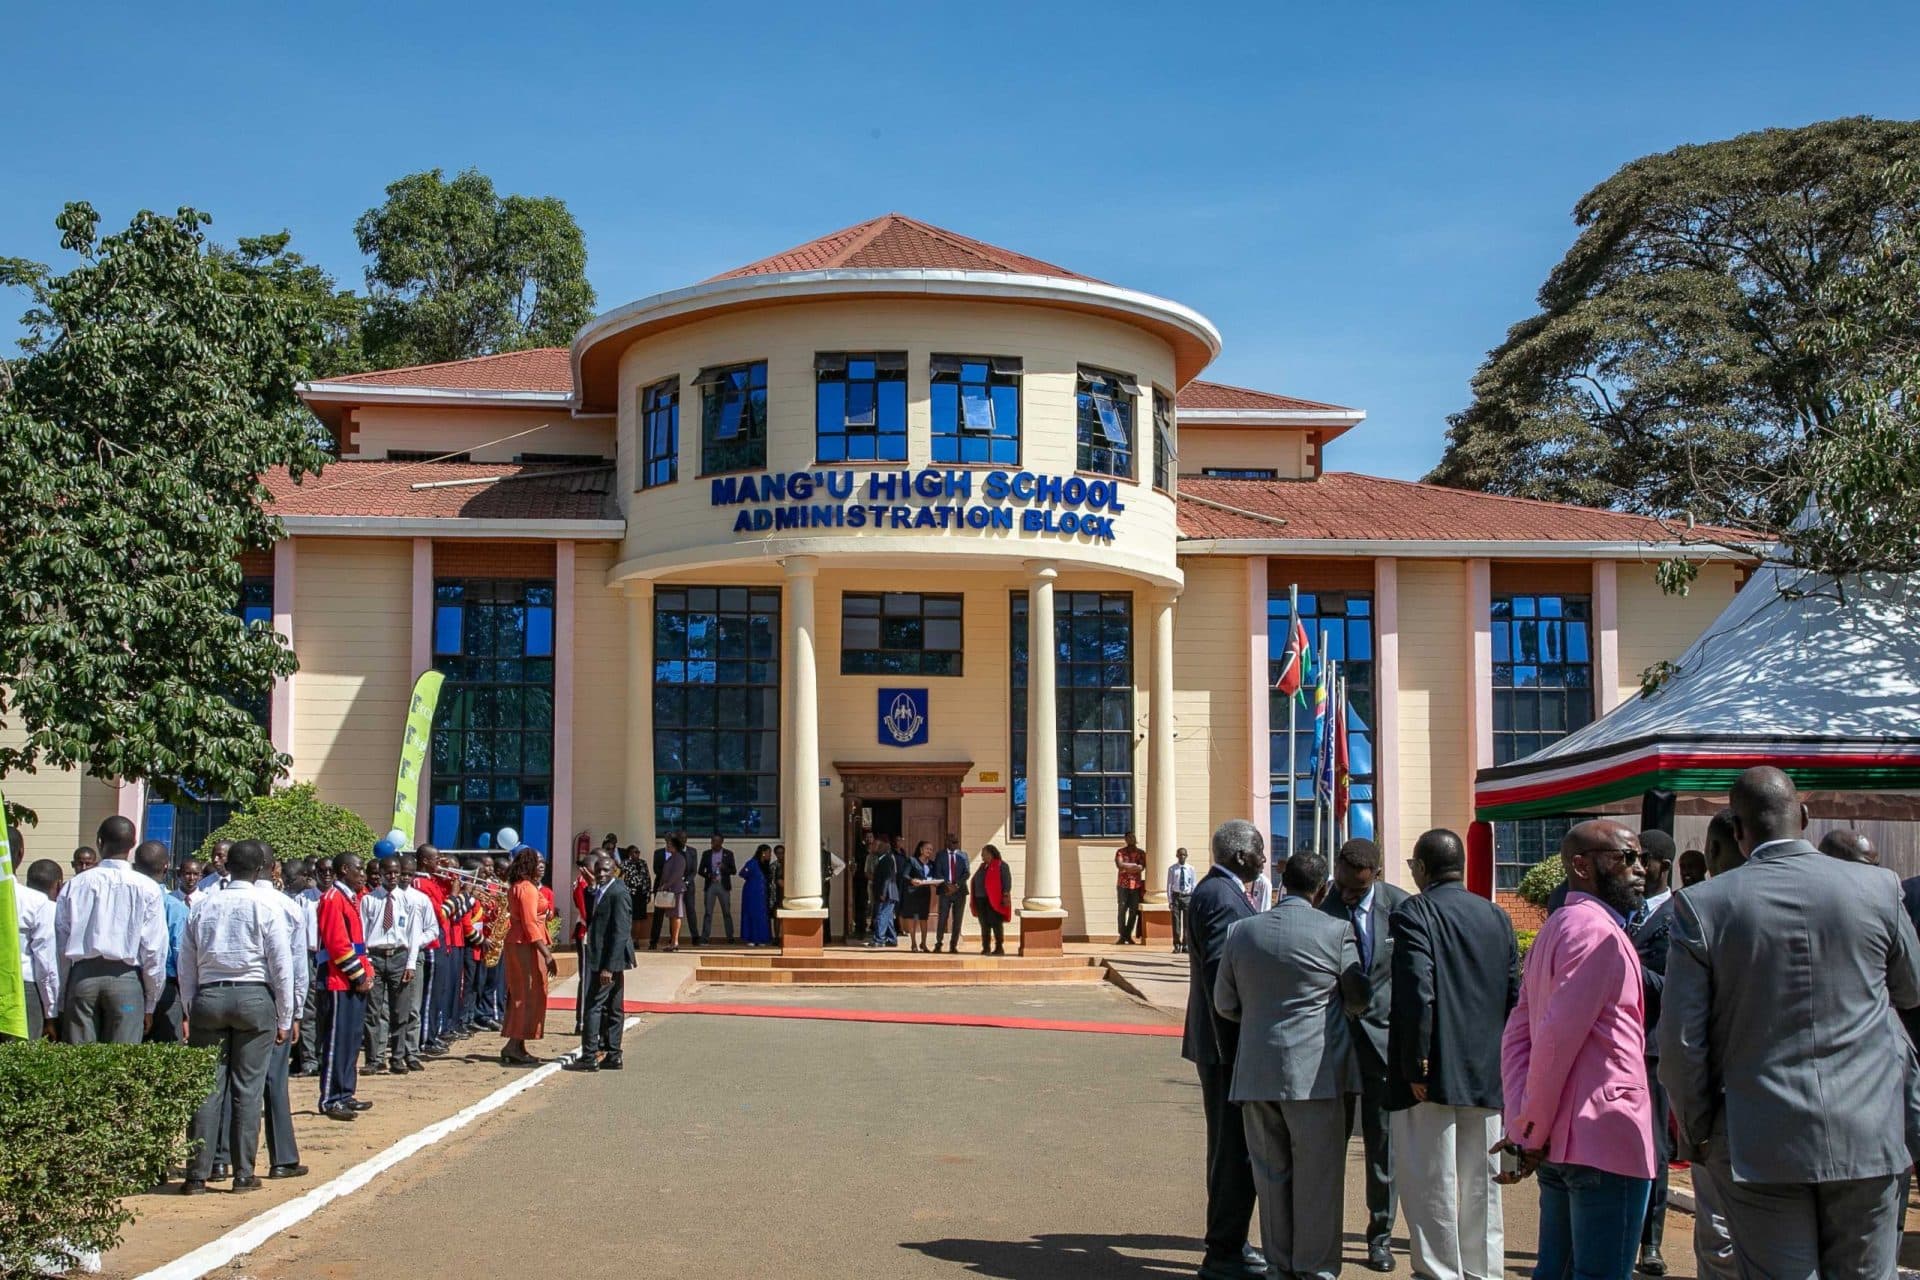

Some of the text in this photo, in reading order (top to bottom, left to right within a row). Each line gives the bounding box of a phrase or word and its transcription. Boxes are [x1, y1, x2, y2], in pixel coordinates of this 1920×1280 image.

[711, 470, 1126, 512] MANG'U HIGH SCHOOL
[733, 504, 1116, 541] ADMINISTRATION BLOCK
